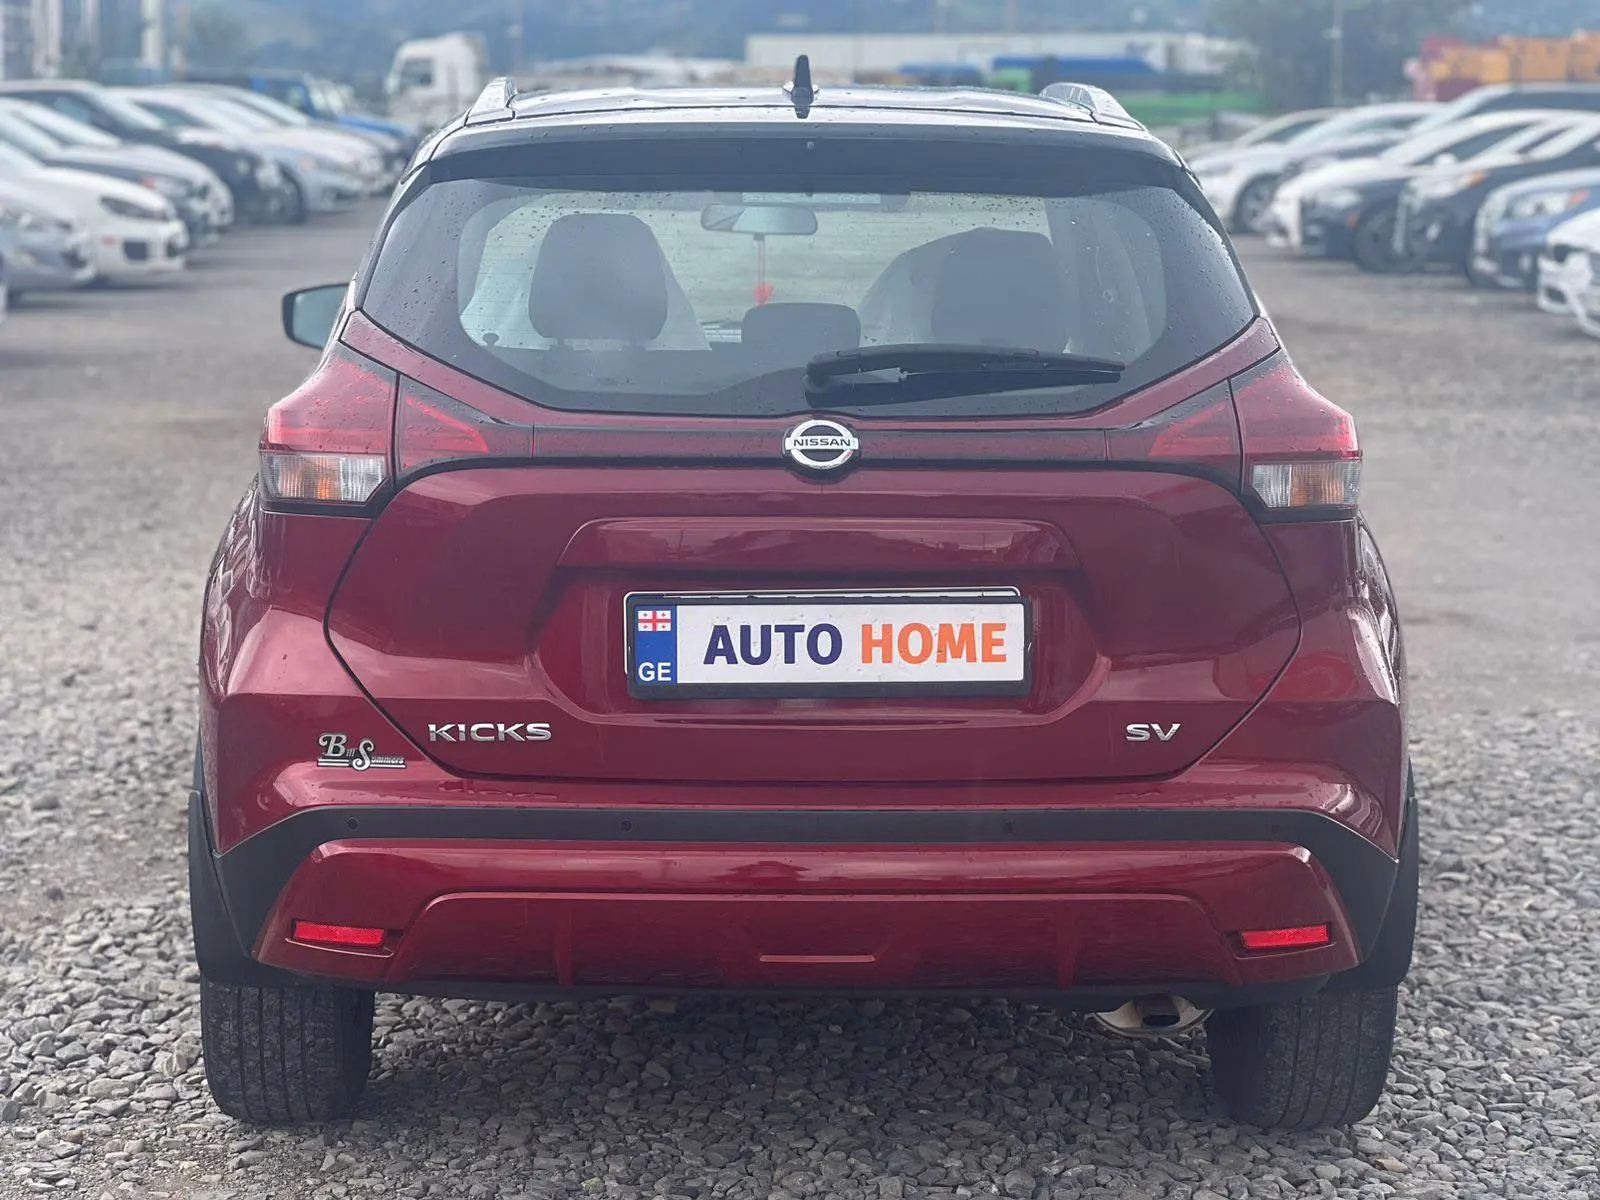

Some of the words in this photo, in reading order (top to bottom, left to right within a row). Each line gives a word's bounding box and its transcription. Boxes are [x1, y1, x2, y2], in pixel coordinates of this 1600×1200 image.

[793, 438, 851, 447] NISSAN
[703, 623, 843, 665] AUTO
[861, 623, 1008, 665] HOME
[638, 662, 672, 682] GE
[428, 723, 552, 742] KICKS
[1126, 723, 1181, 741] SV
